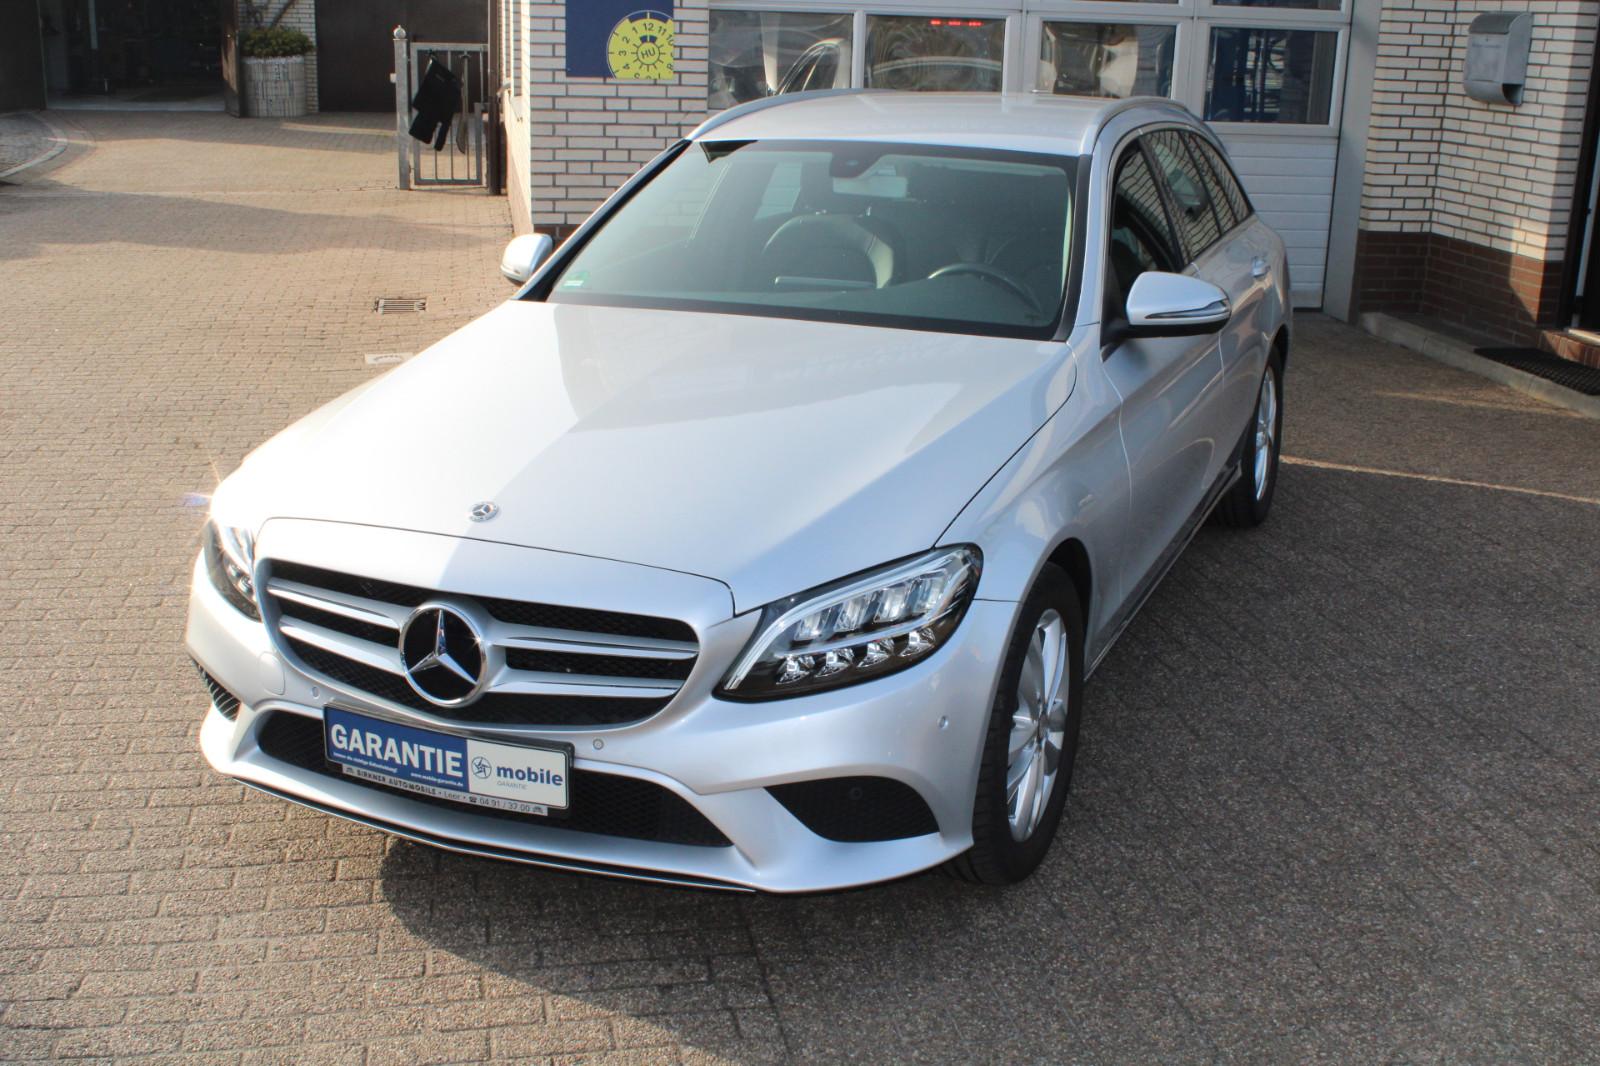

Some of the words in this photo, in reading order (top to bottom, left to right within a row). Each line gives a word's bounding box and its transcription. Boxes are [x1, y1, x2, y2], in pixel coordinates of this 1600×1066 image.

[632, 26, 638, 34] 1
[643, 22, 654, 31] 12
[658, 26, 667, 36] 11
[622, 36, 630, 44] 2
[640, 47, 656, 59] HU
[331, 723, 463, 778] GARANTIE
[496, 765, 563, 786] mobile
[497, 780, 528, 790] GARANTIE
[444, 790, 460, 801] Leer
